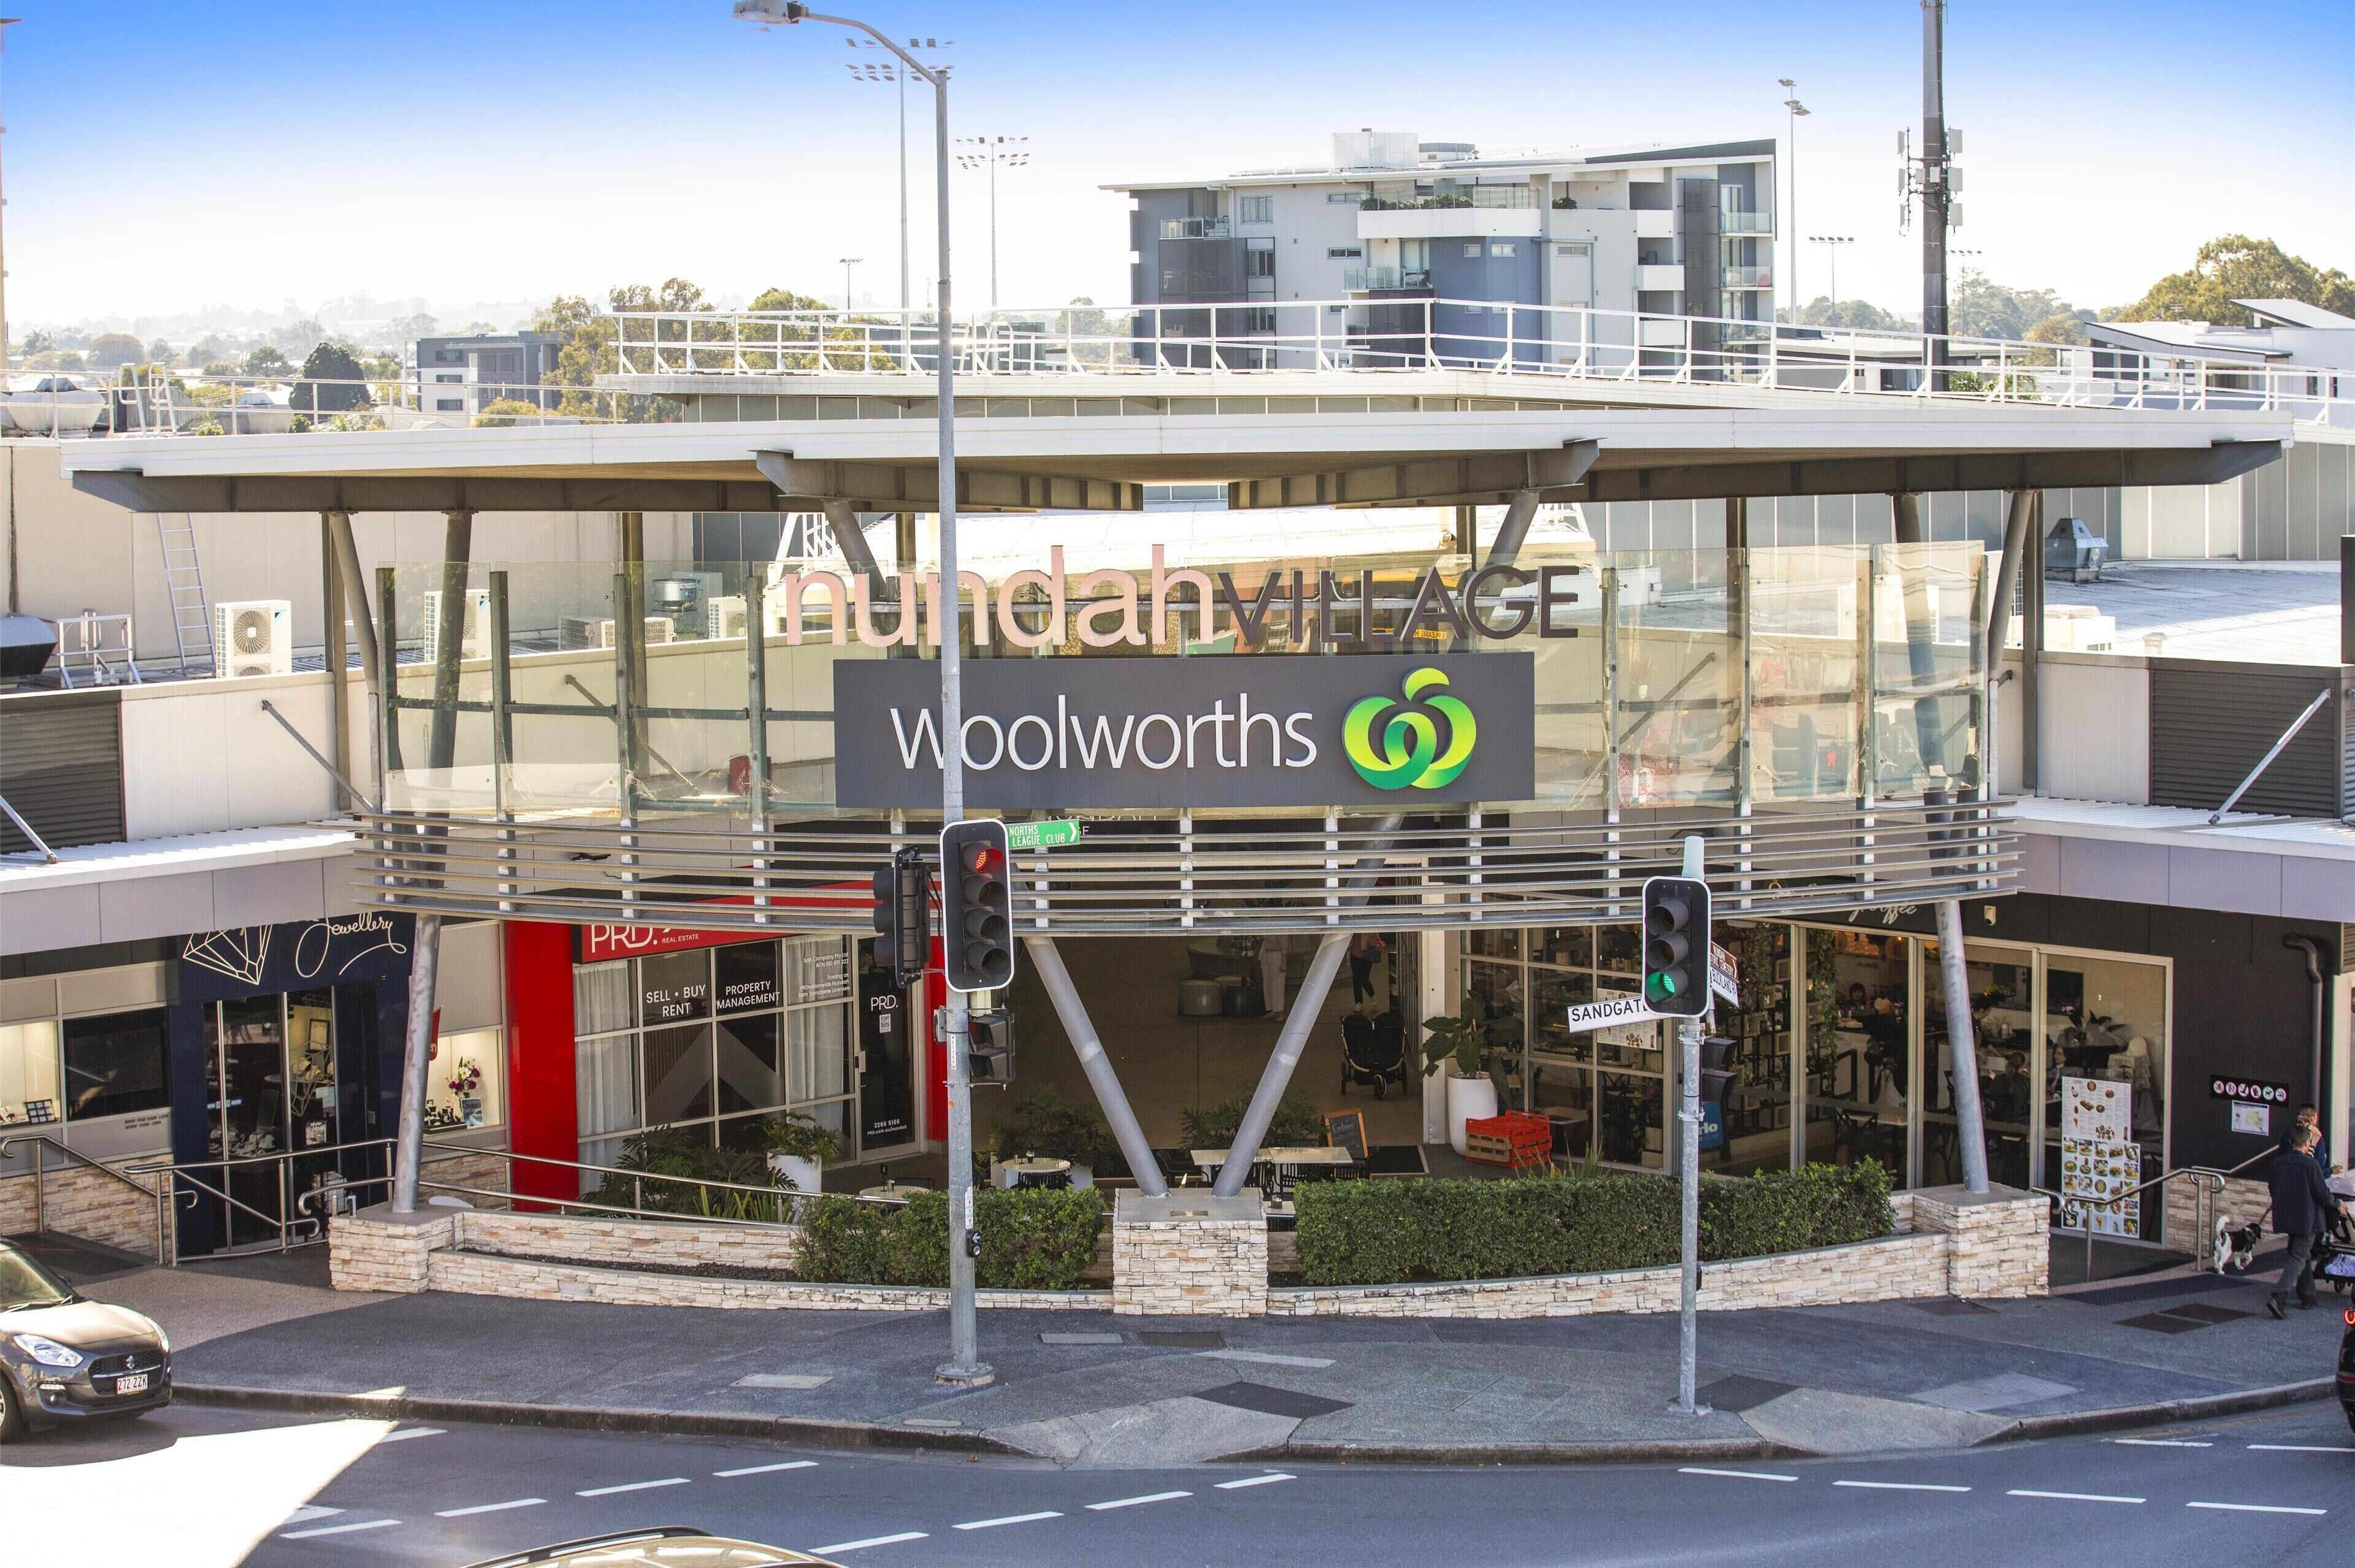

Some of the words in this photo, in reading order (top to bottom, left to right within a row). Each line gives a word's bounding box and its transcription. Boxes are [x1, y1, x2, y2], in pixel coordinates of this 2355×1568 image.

[786, 544, 1214, 648] nundah
[1216, 564, 1579, 644] VILLAGE
[888, 693, 1318, 770] Woolworths
[1009, 825, 1038, 836] NORTHS
[1012, 835, 1041, 847] LEAGUE
[1046, 833, 1066, 844] CLUB
[296, 912, 407, 978] Jewellery
[678, 933, 699, 942] ESTATE
[646, 989, 671, 1004] SELL
[683, 984, 706, 999] BUY
[726, 981, 771, 996] PROPERTY
[716, 992, 781, 1009] MANAGEMENT
[662, 1002, 691, 1017] RENT
[1572, 999, 1648, 1022] SANDGAT
